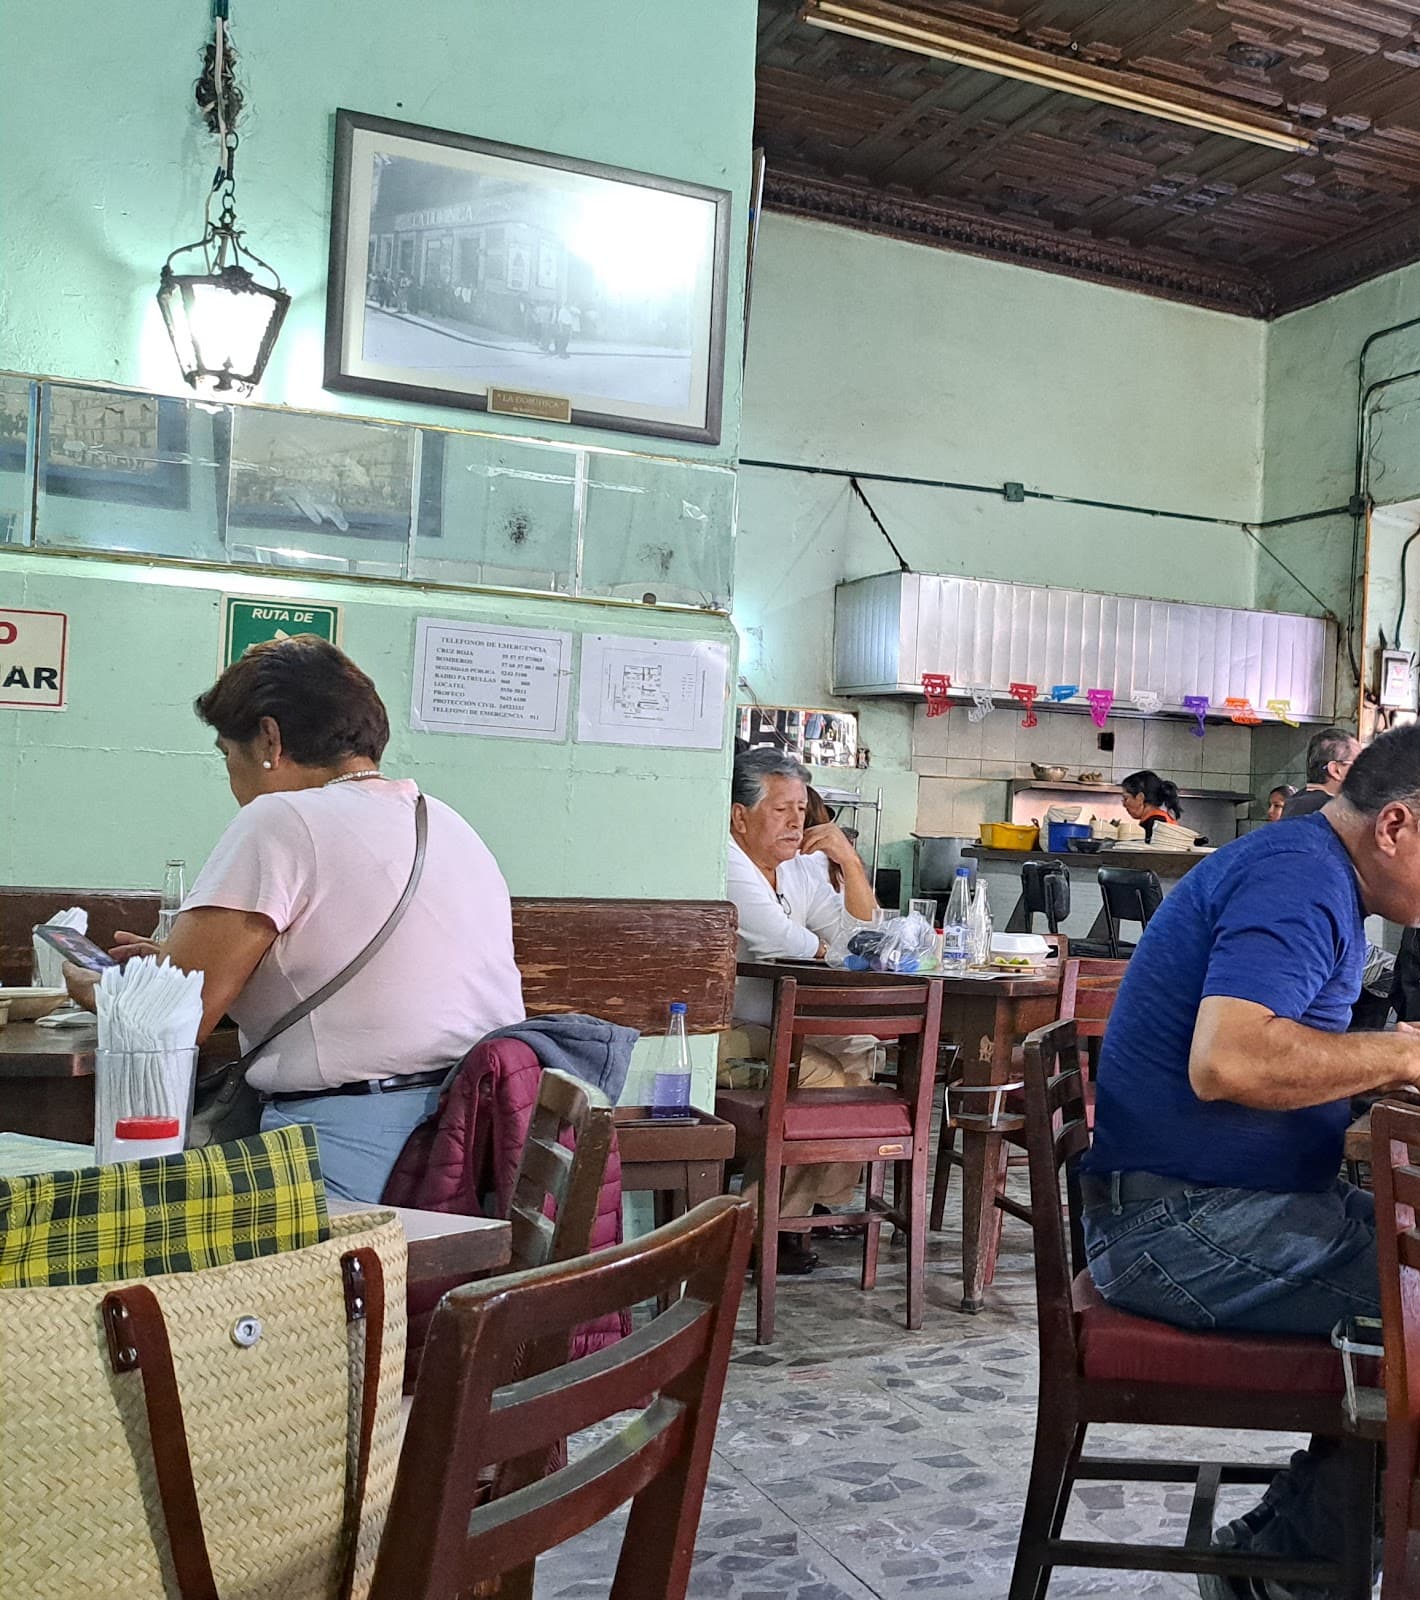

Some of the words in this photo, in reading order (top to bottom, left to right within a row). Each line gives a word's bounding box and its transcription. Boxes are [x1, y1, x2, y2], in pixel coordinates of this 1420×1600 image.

[251, 607, 290, 621] RUTA
[293, 610, 314, 623] DE
[0, 665, 59, 691] AR
